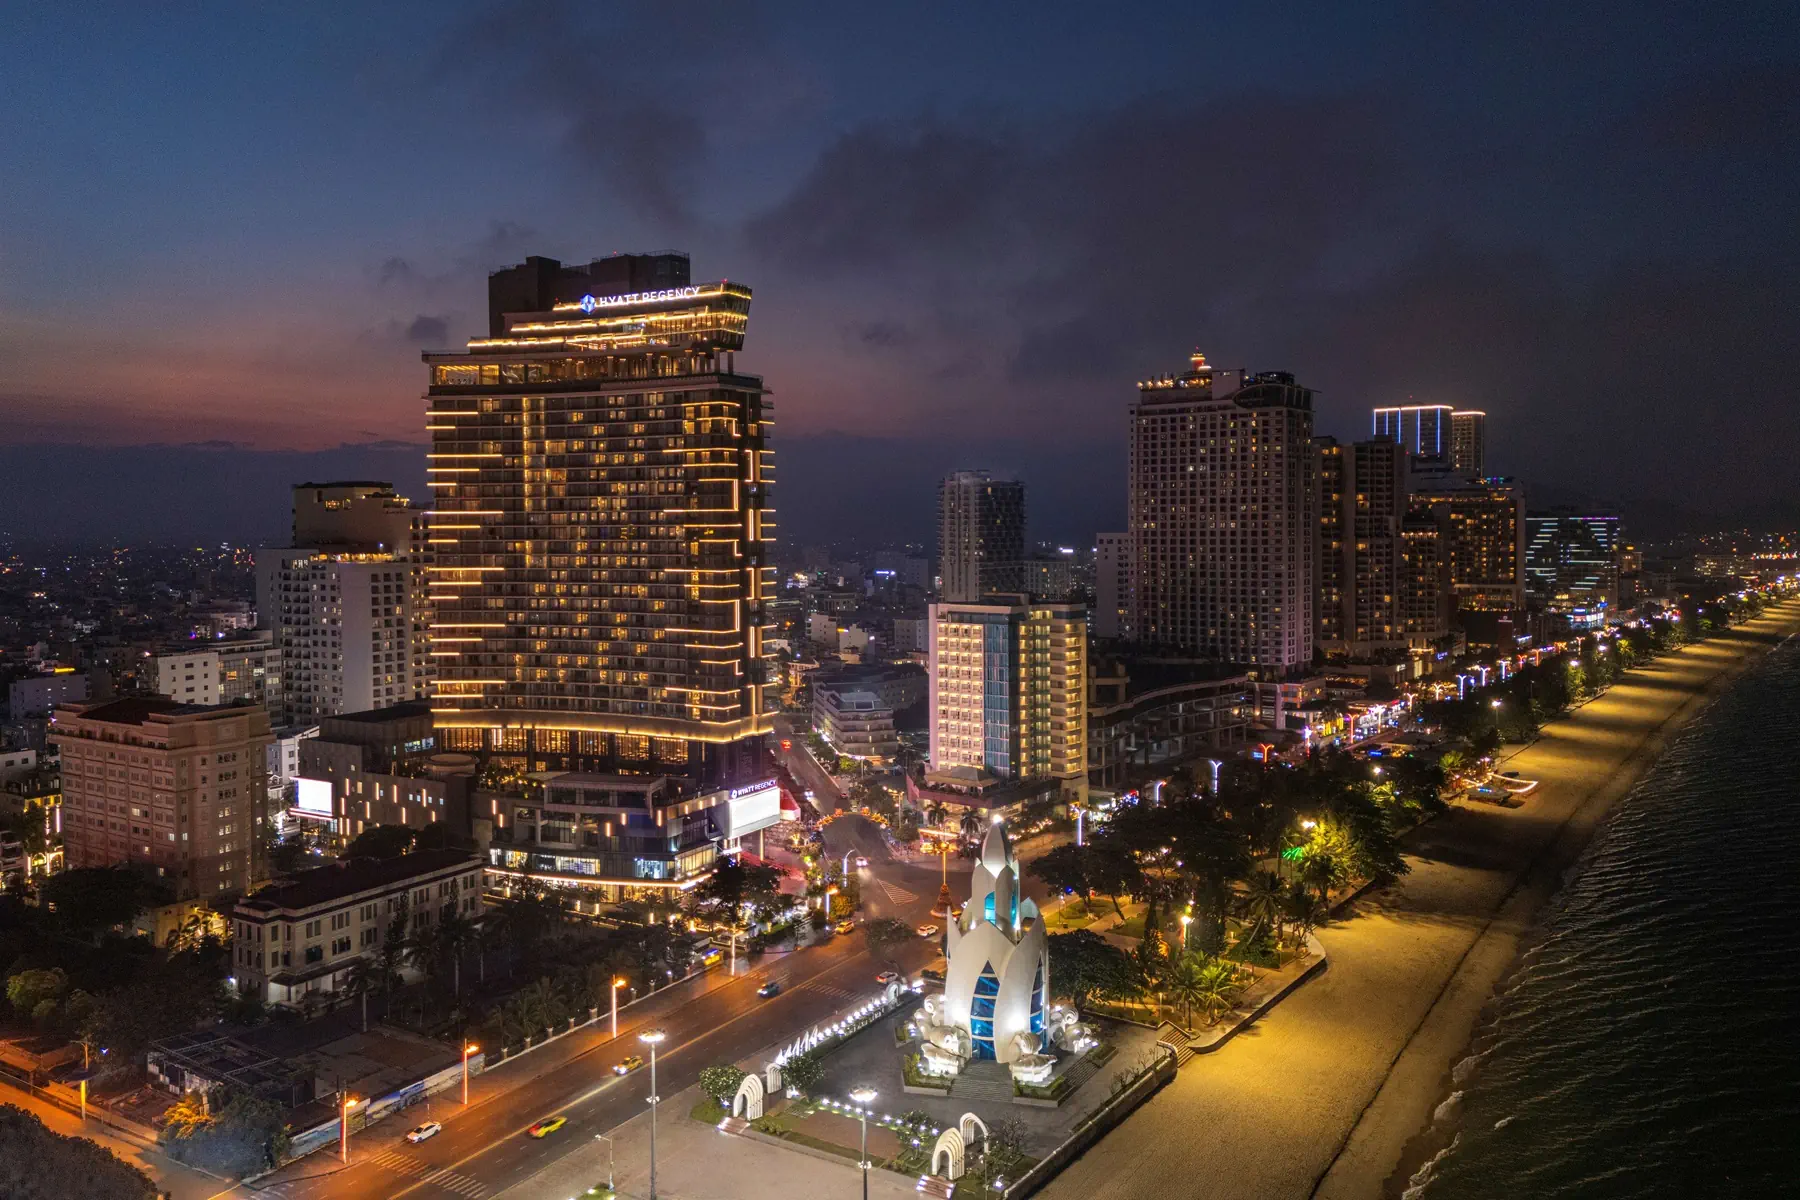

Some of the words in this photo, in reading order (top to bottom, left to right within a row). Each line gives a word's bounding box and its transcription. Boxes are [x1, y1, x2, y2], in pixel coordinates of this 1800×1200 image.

[600, 294, 639, 305] HYATT
[642, 286, 700, 301] REGENCY
[738, 785, 754, 795] HYATT
[755, 779, 776, 790] REGENCY
